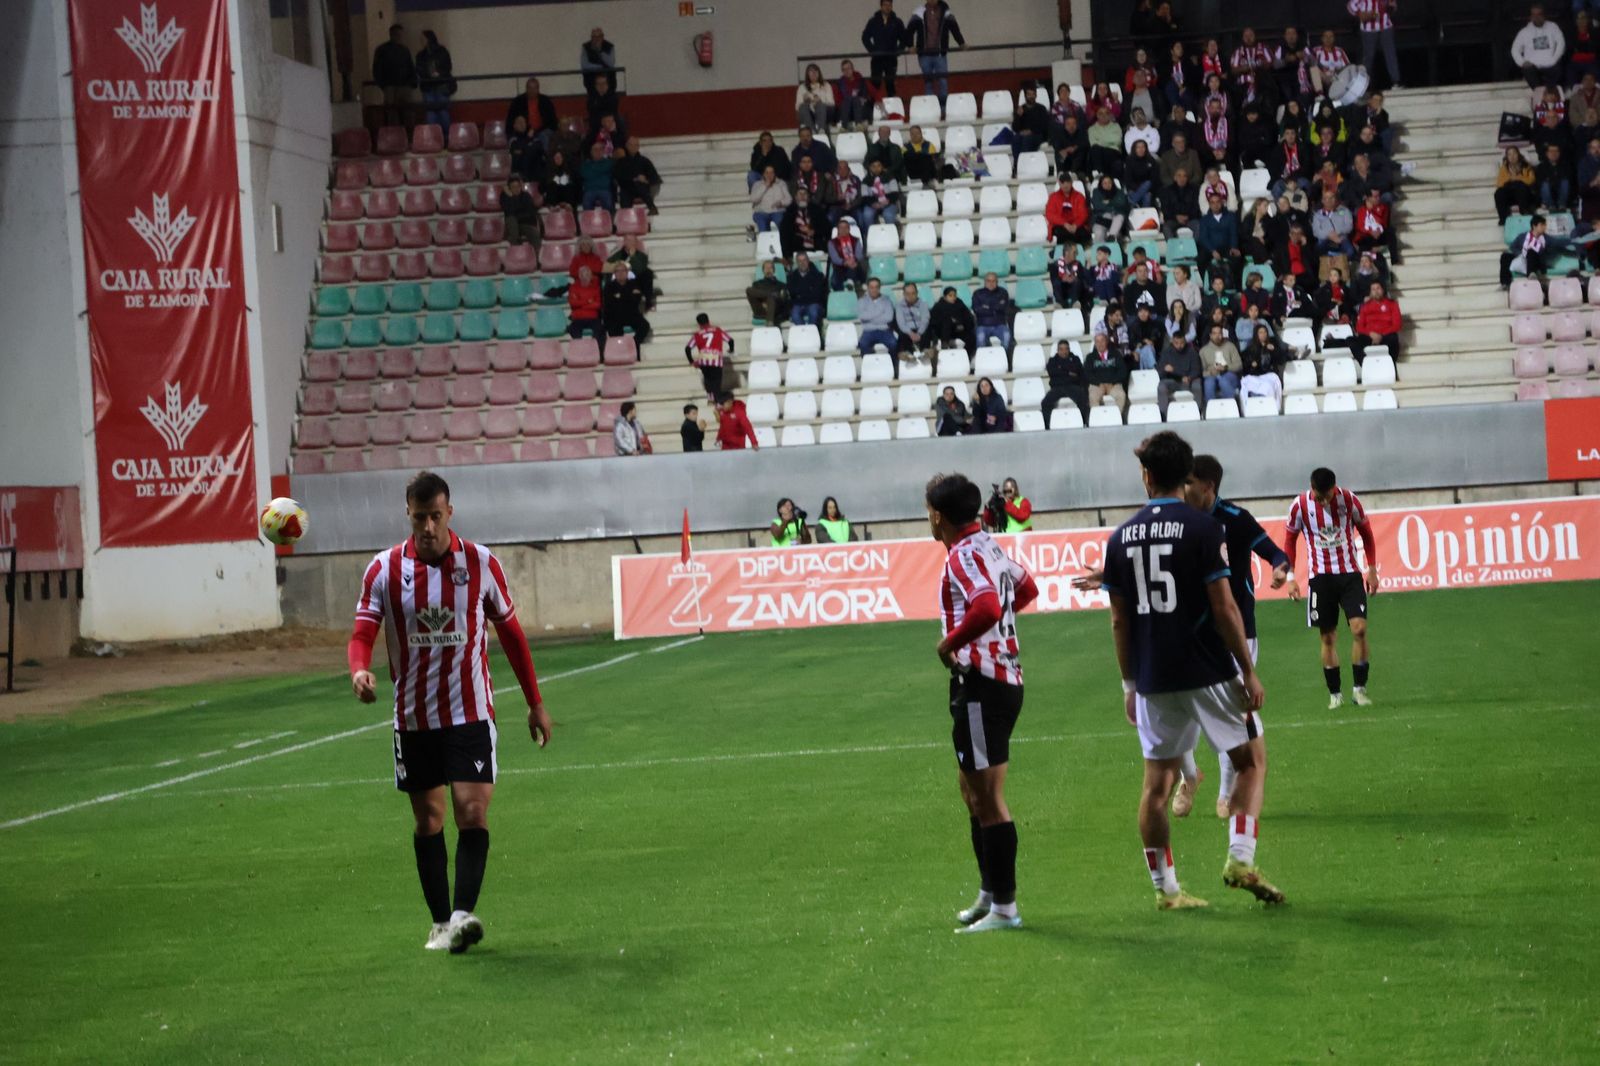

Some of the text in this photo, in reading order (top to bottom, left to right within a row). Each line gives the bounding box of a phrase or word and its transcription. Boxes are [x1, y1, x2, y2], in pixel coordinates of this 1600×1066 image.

[87, 79, 220, 101] CAJA RURAL
[113, 105, 201, 119] DE ZAMORA
[100, 267, 231, 291] CAJA RURAL
[125, 293, 209, 308] DE ZAMORA
[702, 333, 714, 348] 7
[112, 454, 242, 481] CAJA RURAL
[136, 481, 221, 497] DE ZAMORA
[1122, 521, 1184, 544] IKER ALDAI
[1398, 511, 1581, 588] Opinión
[1126, 543, 1177, 615] 15
[1452, 567, 1475, 585] de
[1479, 566, 1553, 585] Zamora
[727, 586, 905, 628] ZAMORA
[433, 634, 464, 644] RURAL
